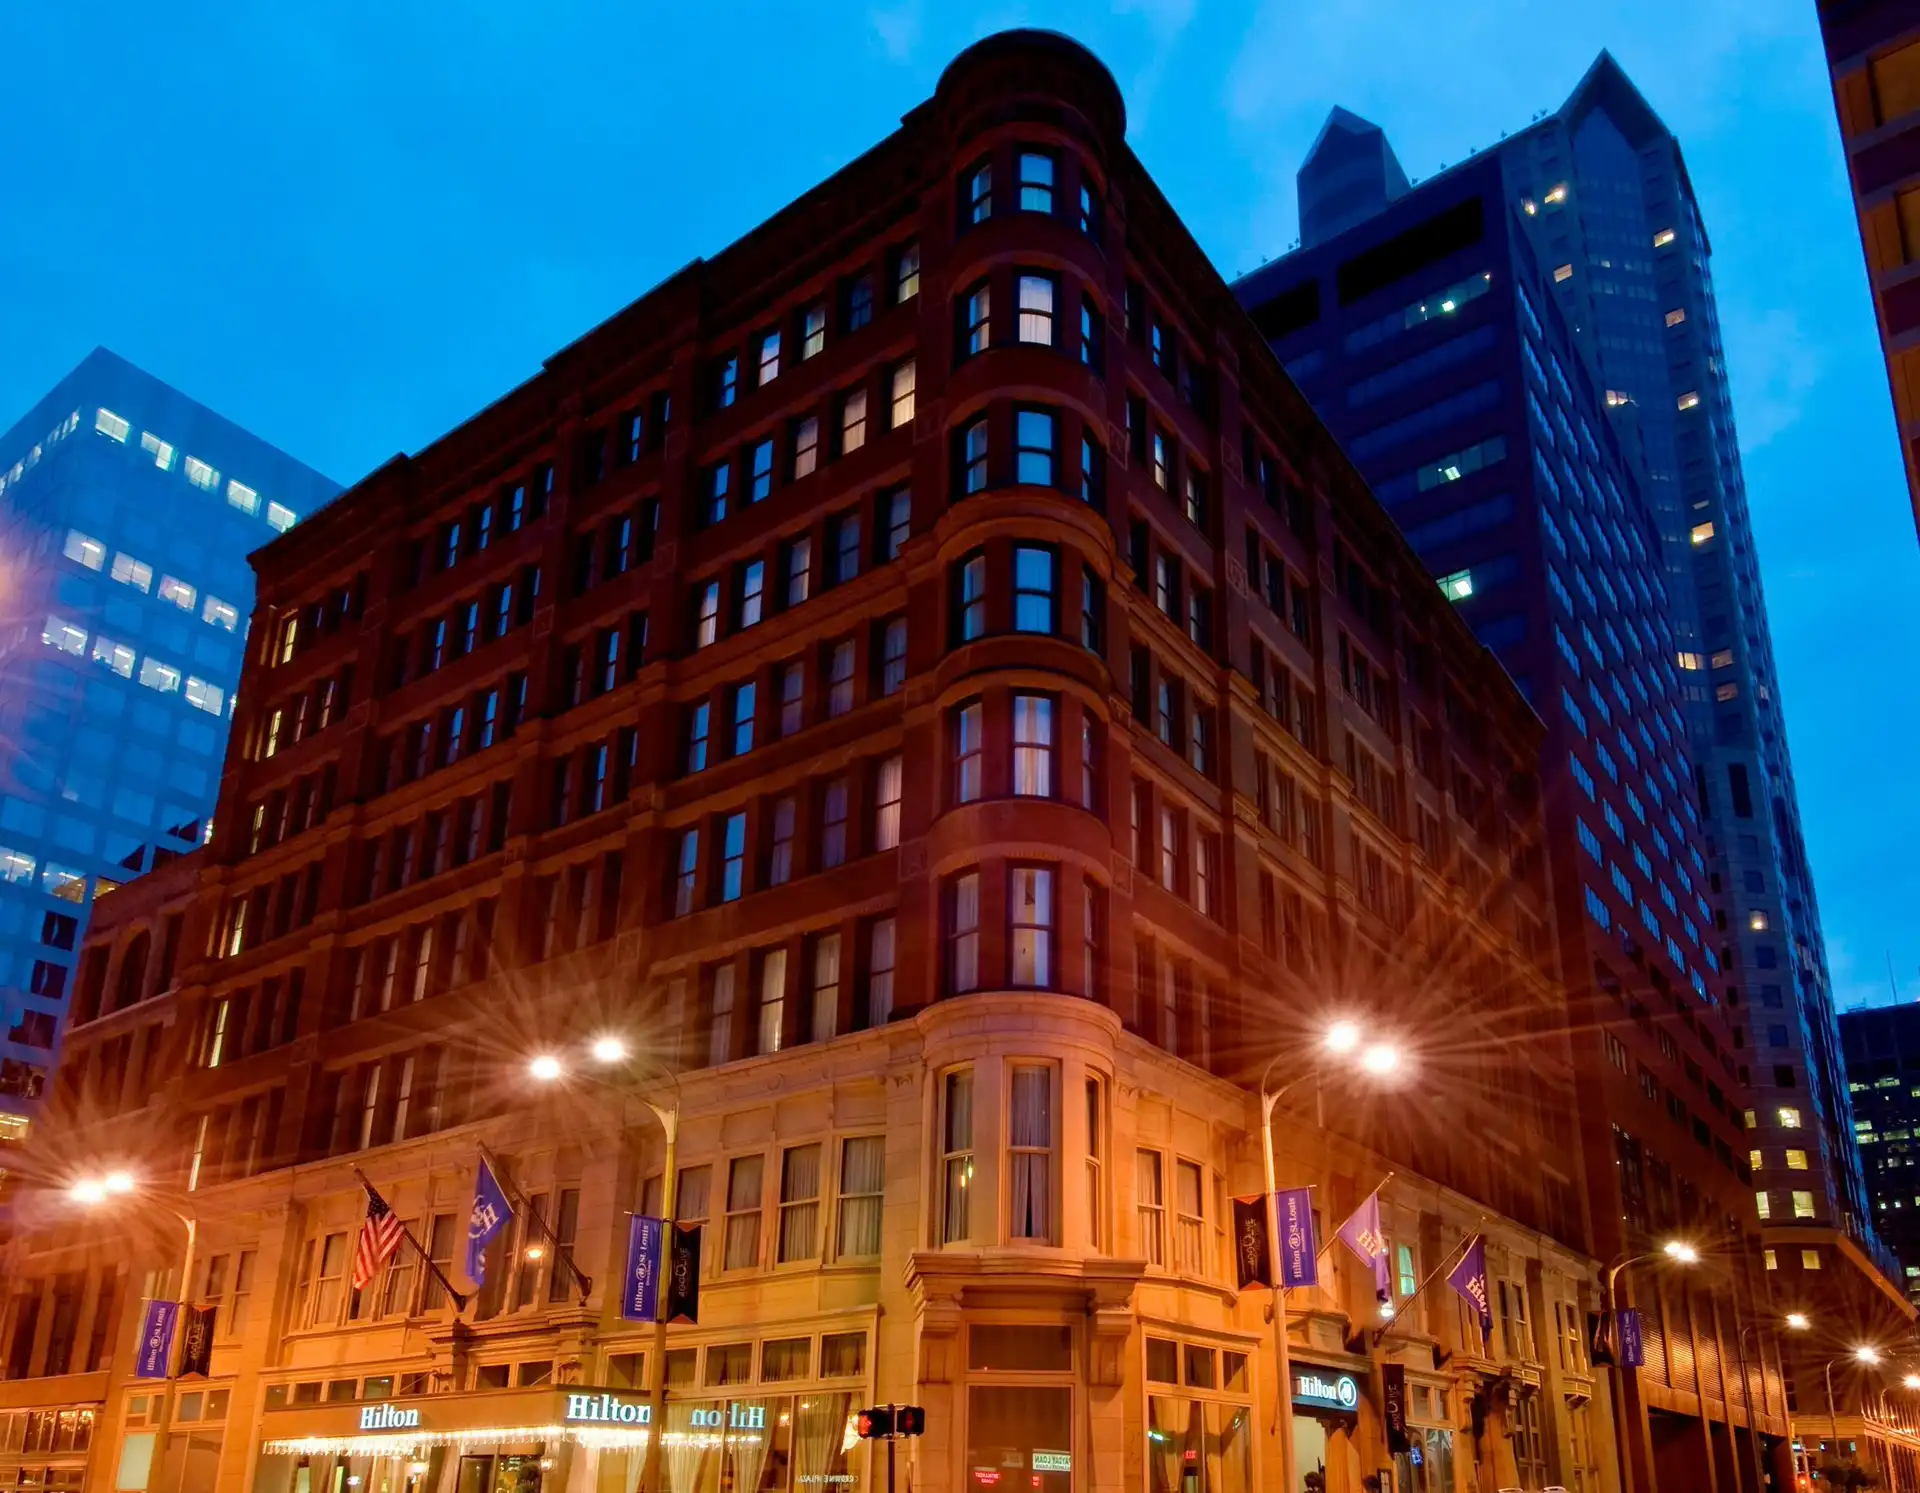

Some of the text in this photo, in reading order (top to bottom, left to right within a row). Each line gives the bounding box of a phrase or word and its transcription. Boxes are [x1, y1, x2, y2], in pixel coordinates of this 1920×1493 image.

[1288, 1197, 1297, 1221] Louis
[634, 1281, 644, 1312] Hilton
[640, 1225, 649, 1250] Louis
[1292, 1250, 1302, 1278] Hilton
[1299, 1376, 1337, 1400] Hilton
[360, 1403, 419, 1429] Hilton
[567, 1394, 651, 1424] Hilton
